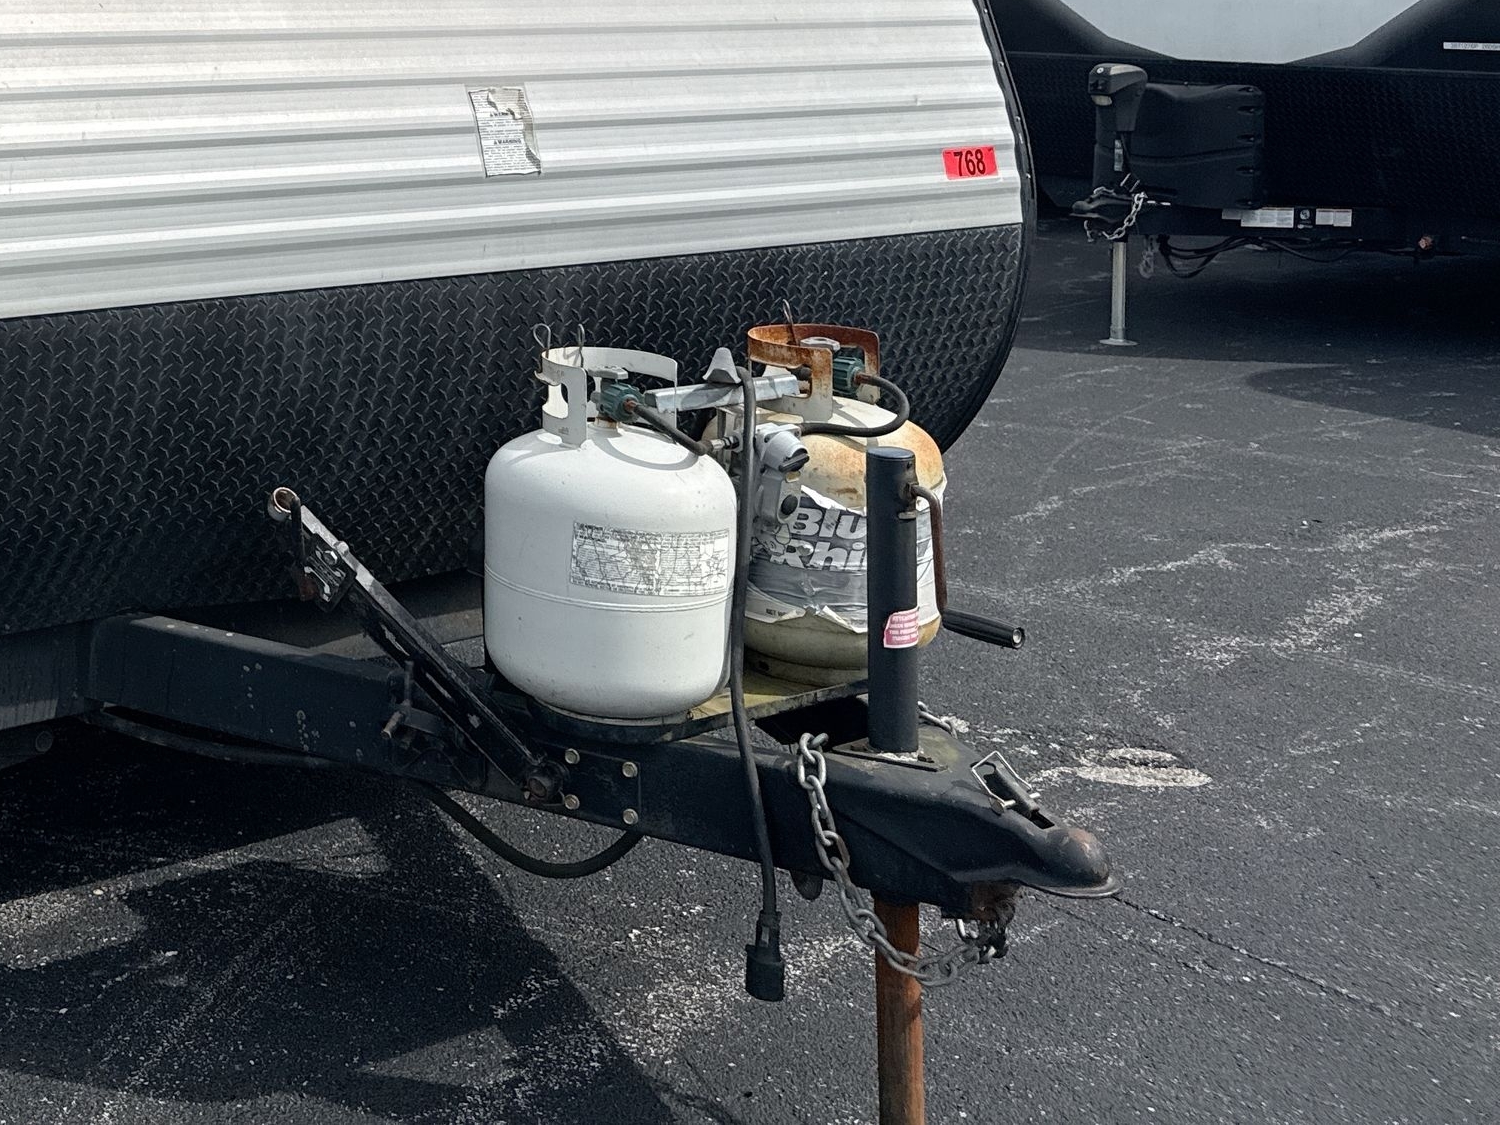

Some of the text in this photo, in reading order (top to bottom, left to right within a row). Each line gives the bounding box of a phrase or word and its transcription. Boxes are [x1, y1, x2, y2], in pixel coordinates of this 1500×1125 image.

[953, 148, 986, 177] 768
[788, 507, 868, 540] Blu
[770, 539, 868, 572] Rhi
